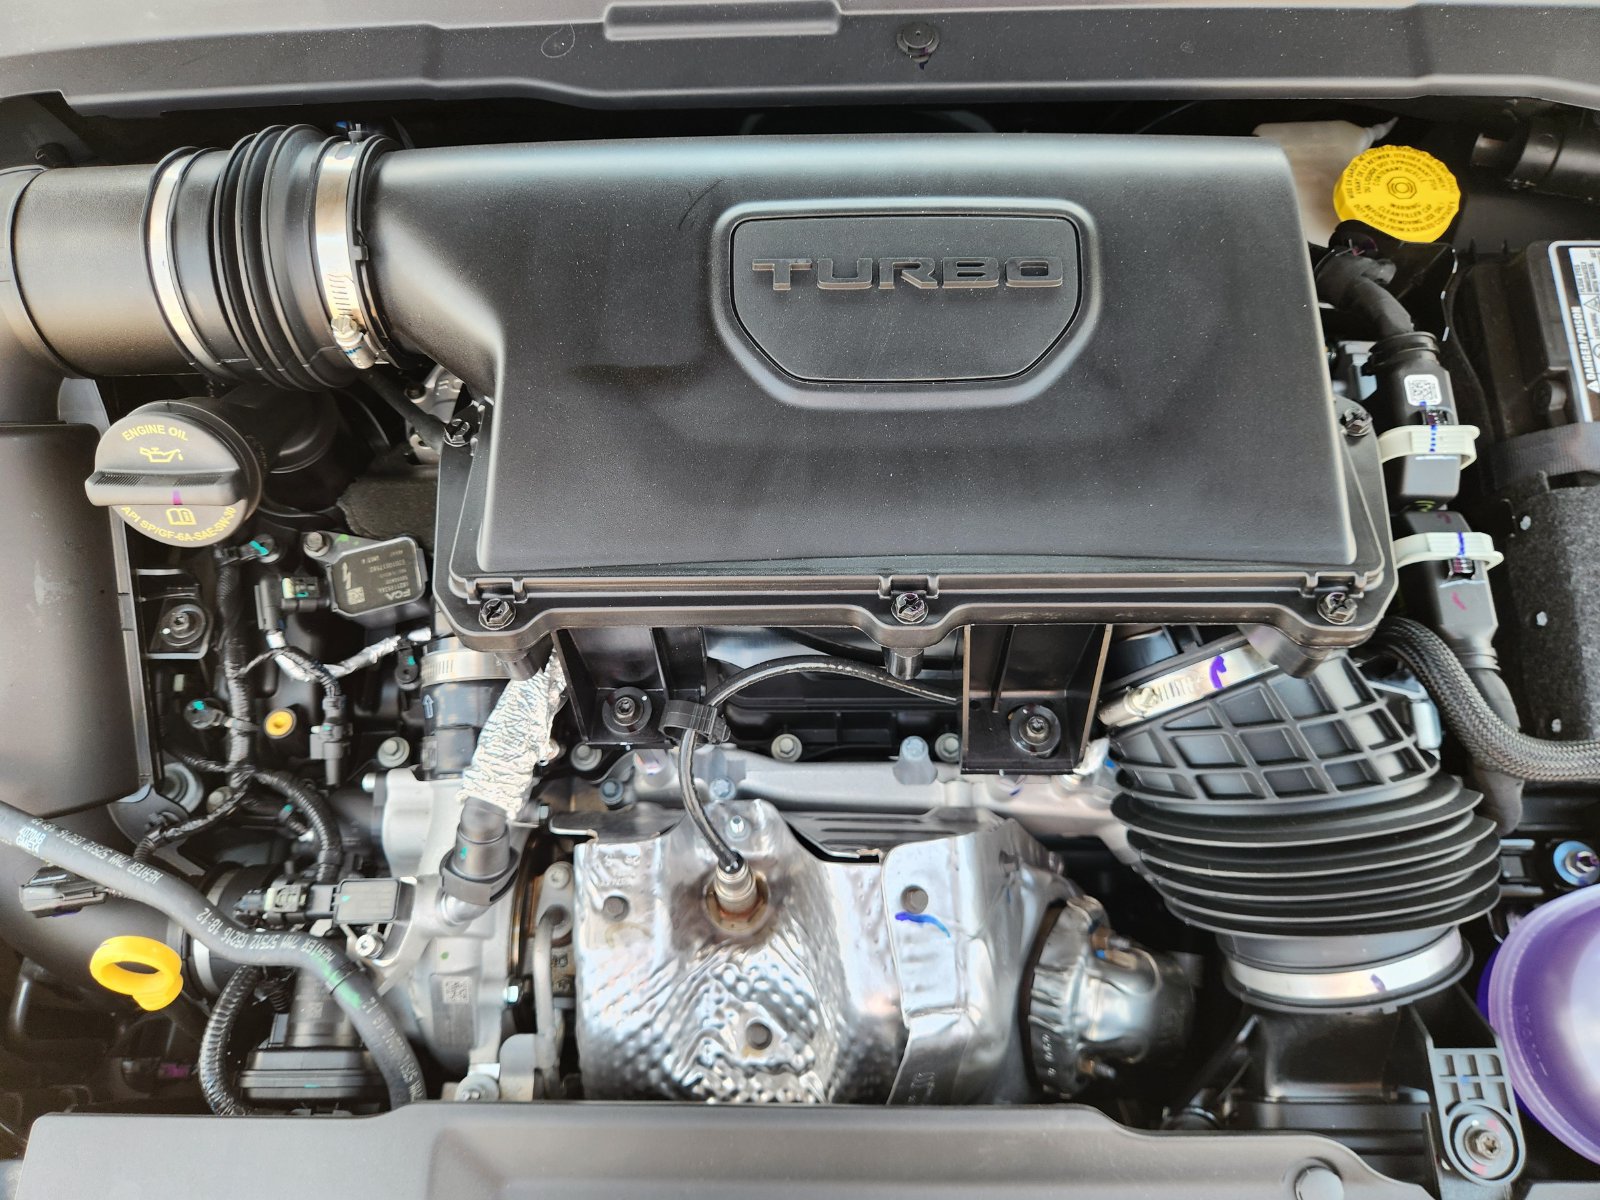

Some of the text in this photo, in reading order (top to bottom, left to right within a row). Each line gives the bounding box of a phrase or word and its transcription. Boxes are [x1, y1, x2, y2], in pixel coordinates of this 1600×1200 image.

[752, 256, 1063, 291] TURBO
[1571, 306, 1597, 380] DANGER/POISON
[122, 424, 188, 441] ENGINE OIL
[121, 506, 141, 522] API
[385, 588, 411, 600] FCA
[127, 861, 164, 884] HEATER
[196, 907, 223, 935] 18:12
[250, 934, 280, 950] 57512
[300, 938, 336, 962] HEATER
